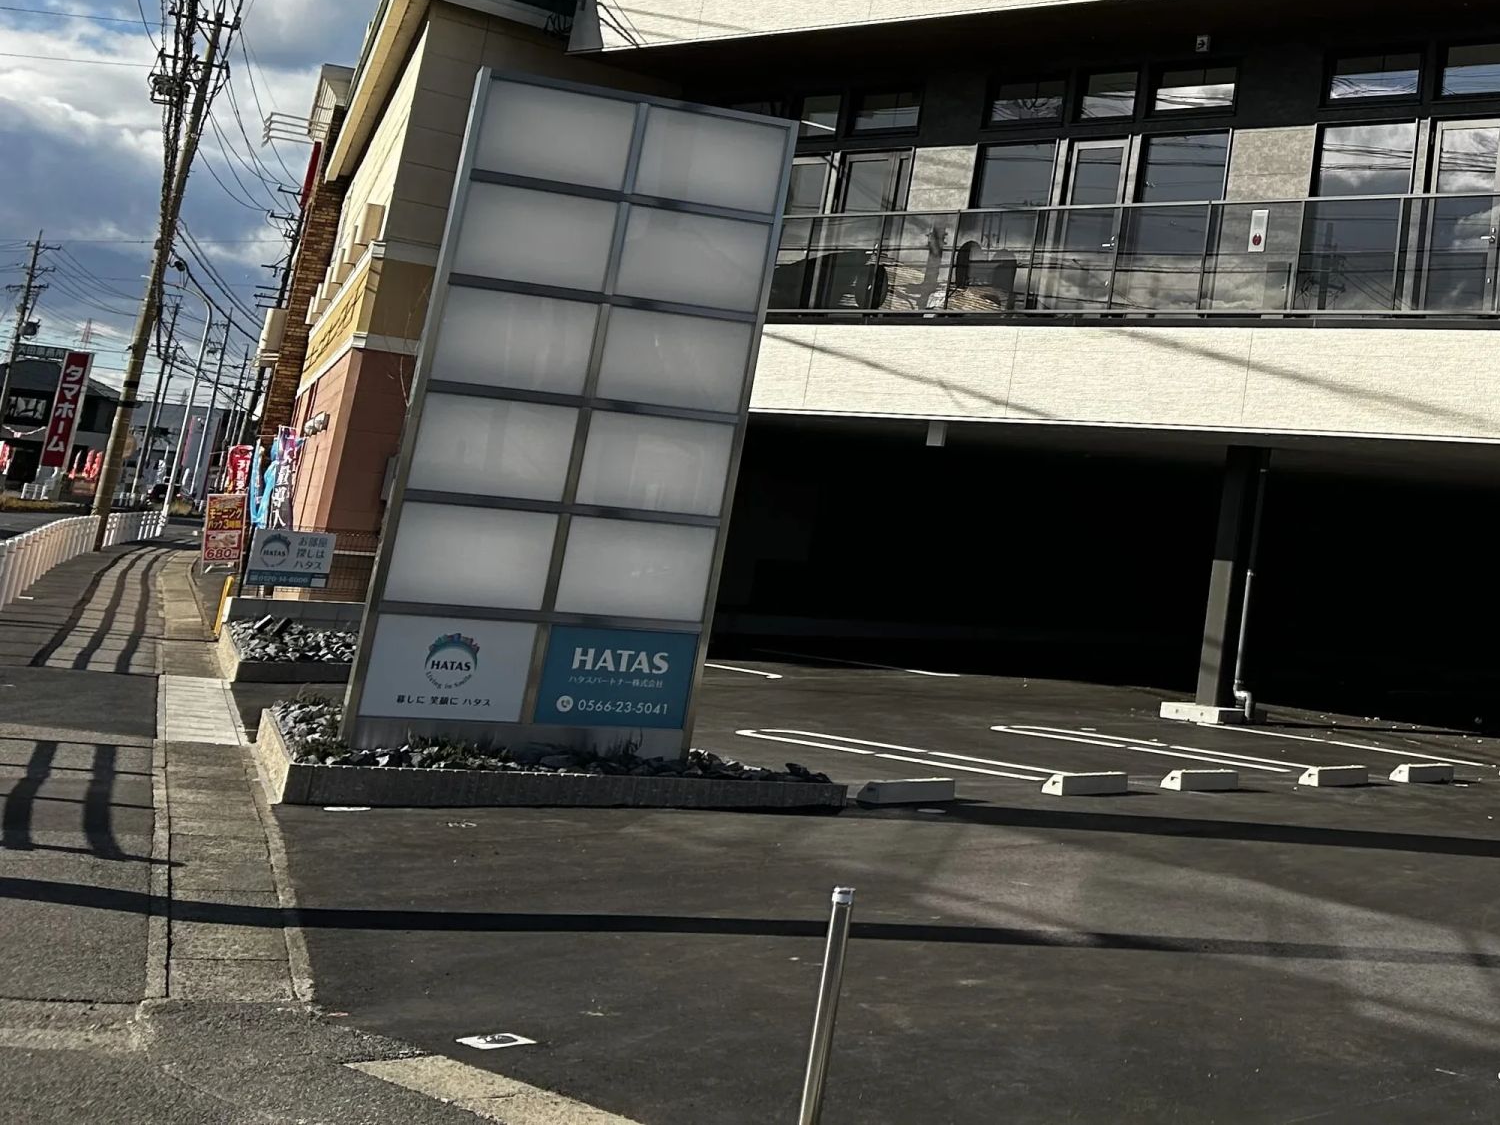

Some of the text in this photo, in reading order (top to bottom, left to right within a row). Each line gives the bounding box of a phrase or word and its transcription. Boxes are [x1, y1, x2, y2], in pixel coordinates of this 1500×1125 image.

[46, 364, 83, 453] タマホーム
[209, 507, 243, 519] モーニング
[294, 560, 322, 570] ハタス
[431, 660, 471, 671] HATAS
[572, 647, 669, 674] HATAS
[568, 675, 664, 688] ハタスパートナー株式会社
[430, 696, 459, 705] 笑顔に
[462, 698, 491, 706] ハタス
[578, 699, 668, 715] 0566-23-5041
